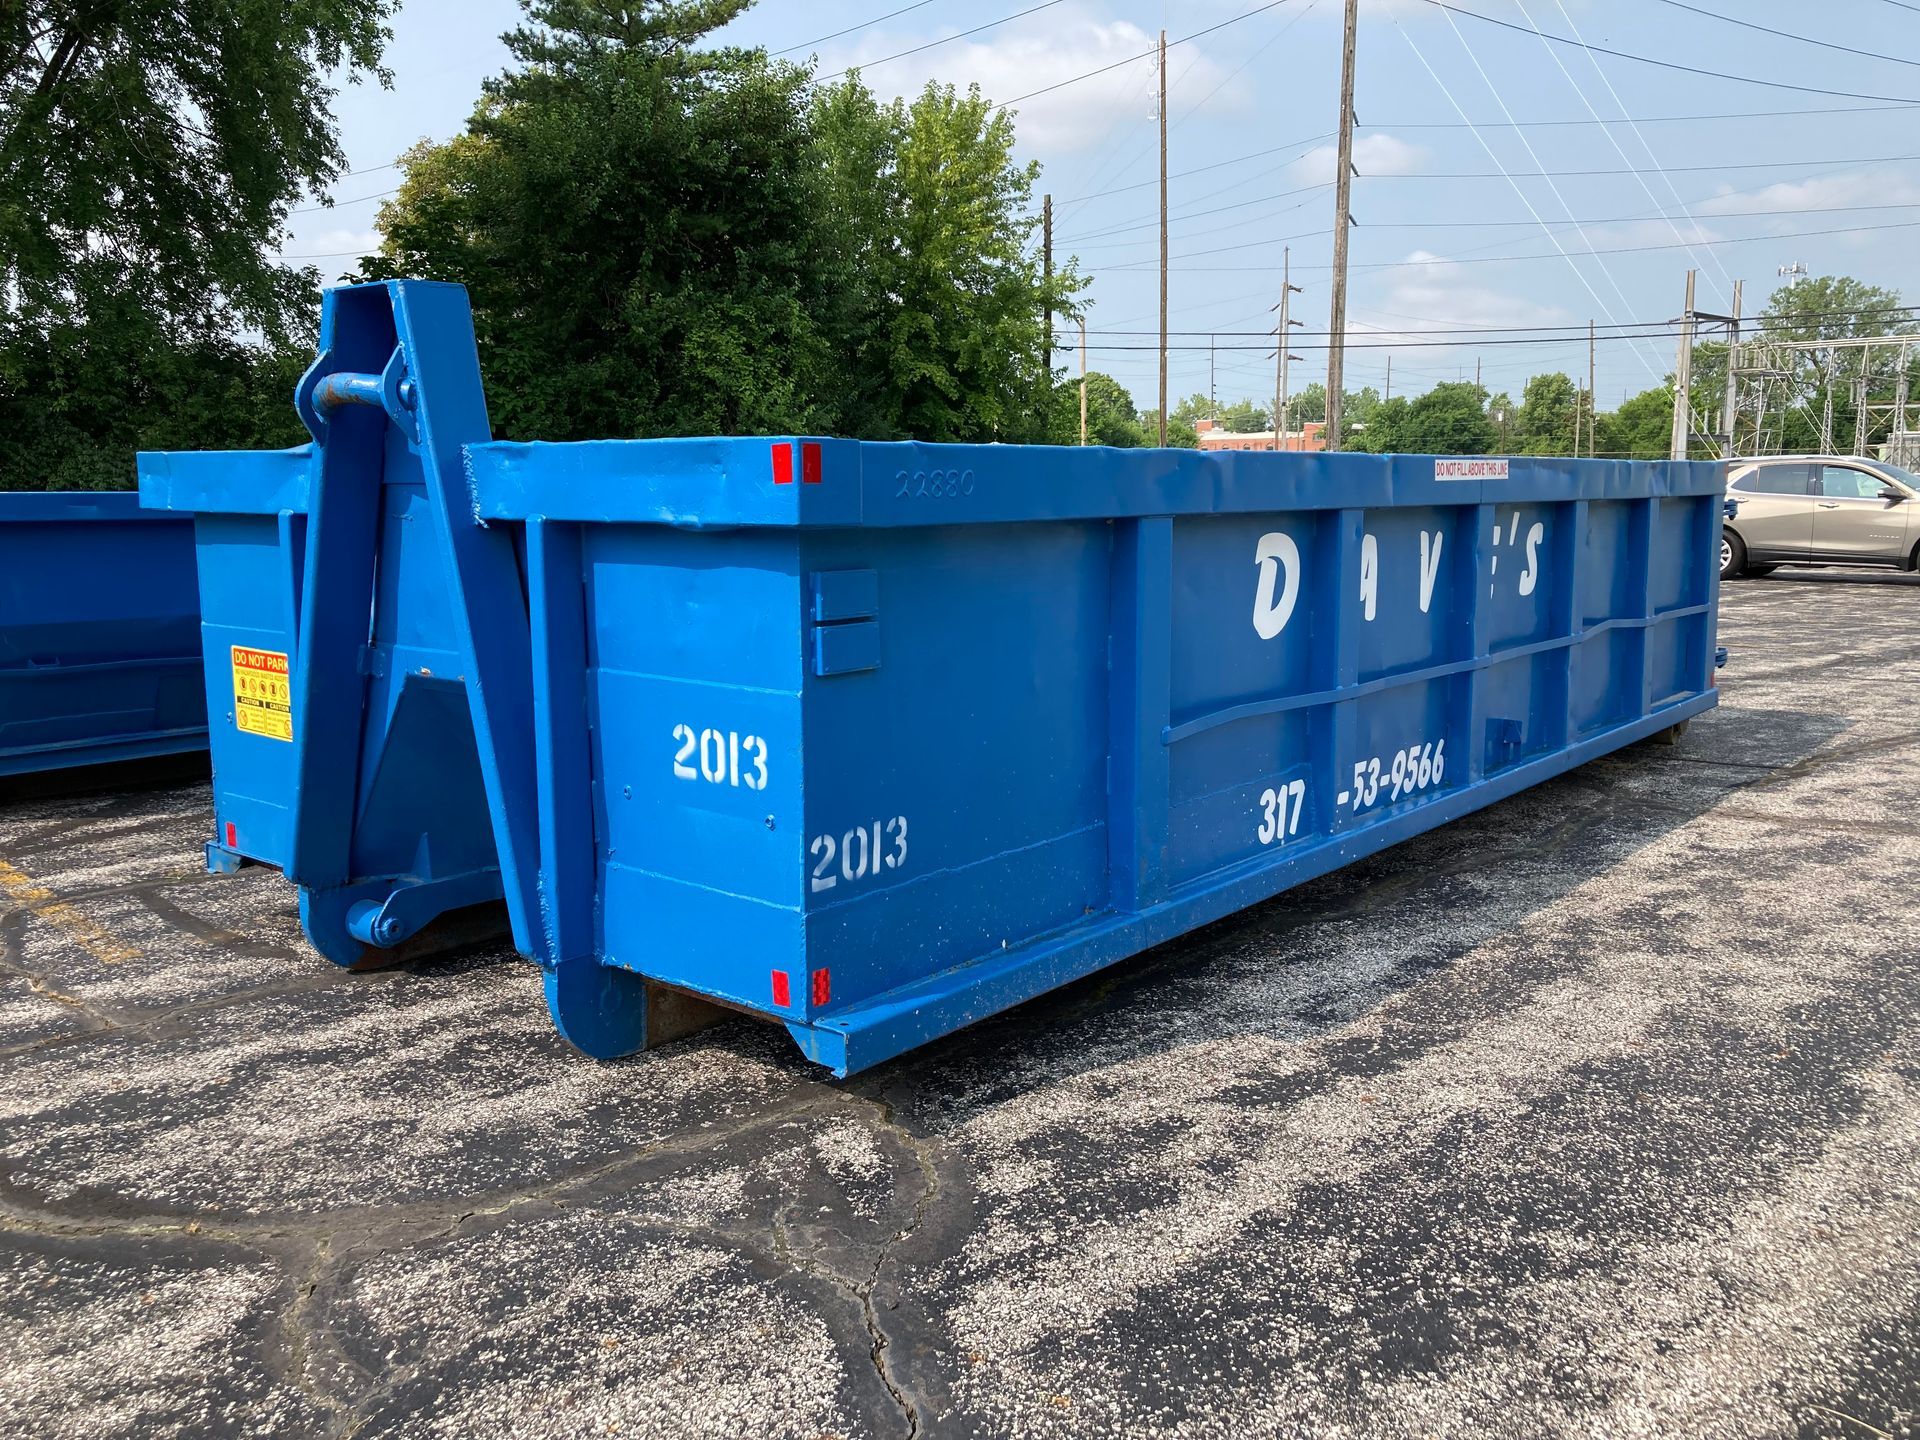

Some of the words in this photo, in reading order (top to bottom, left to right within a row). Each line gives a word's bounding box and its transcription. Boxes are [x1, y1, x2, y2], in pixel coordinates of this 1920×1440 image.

[895, 469, 975, 498] 22880
[1436, 462, 1445, 476] DO
[1445, 462, 1457, 476] NOT
[1457, 462, 1468, 476] FILL
[1468, 462, 1485, 476] ABOVE
[1486, 462, 1497, 476] THIS
[1497, 462, 1507, 475] LINE
[235, 651, 247, 664] DO
[248, 653, 265, 668] NOT
[672, 723, 768, 791] 2013
[810, 815, 908, 893] 2013
